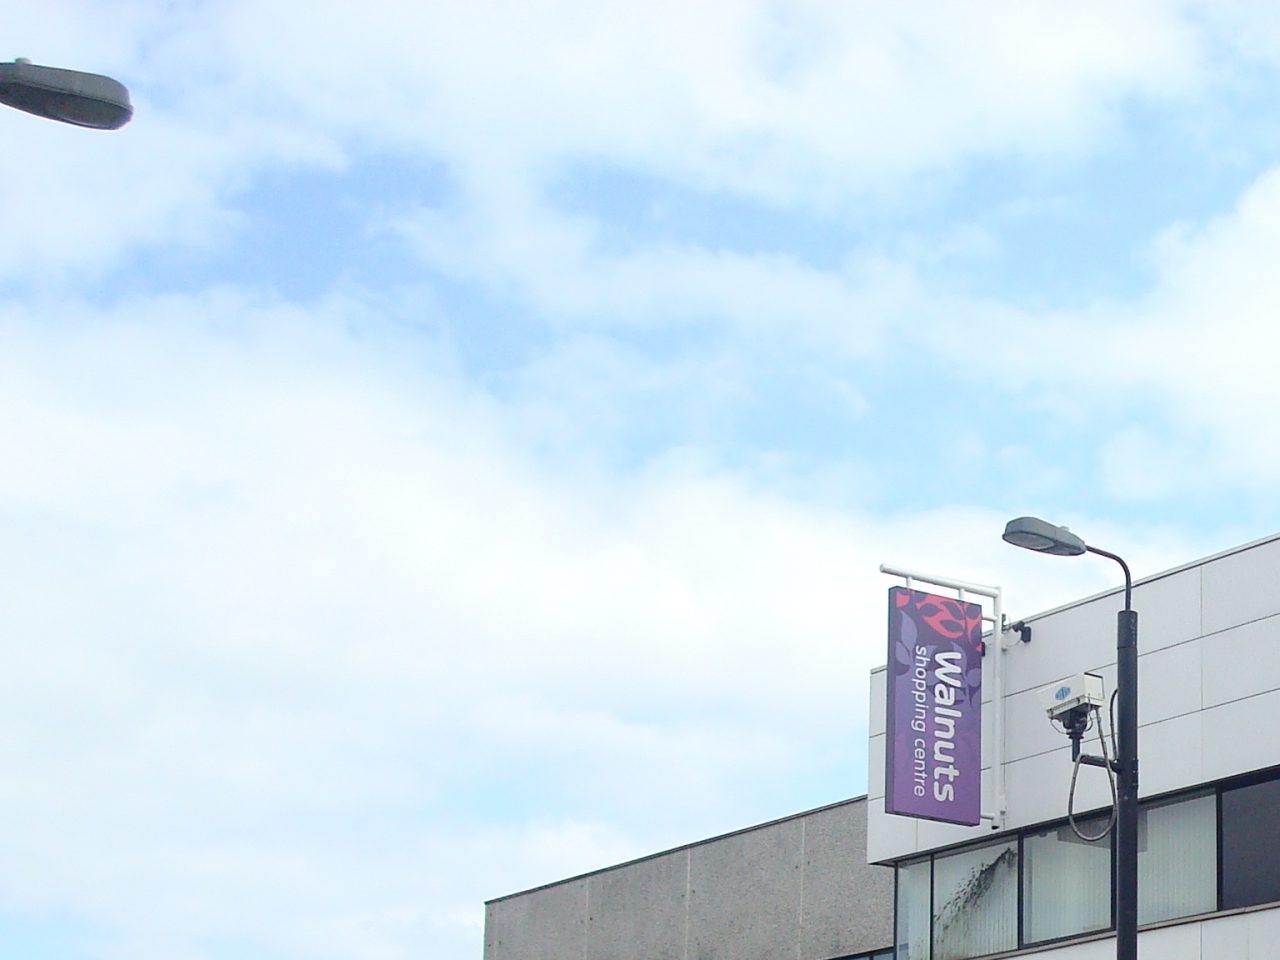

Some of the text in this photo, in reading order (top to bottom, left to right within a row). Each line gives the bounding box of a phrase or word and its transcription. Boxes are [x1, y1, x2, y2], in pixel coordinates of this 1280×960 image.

[911, 645, 930, 797] shopping centre
[933, 651, 962, 802] Walnuts
